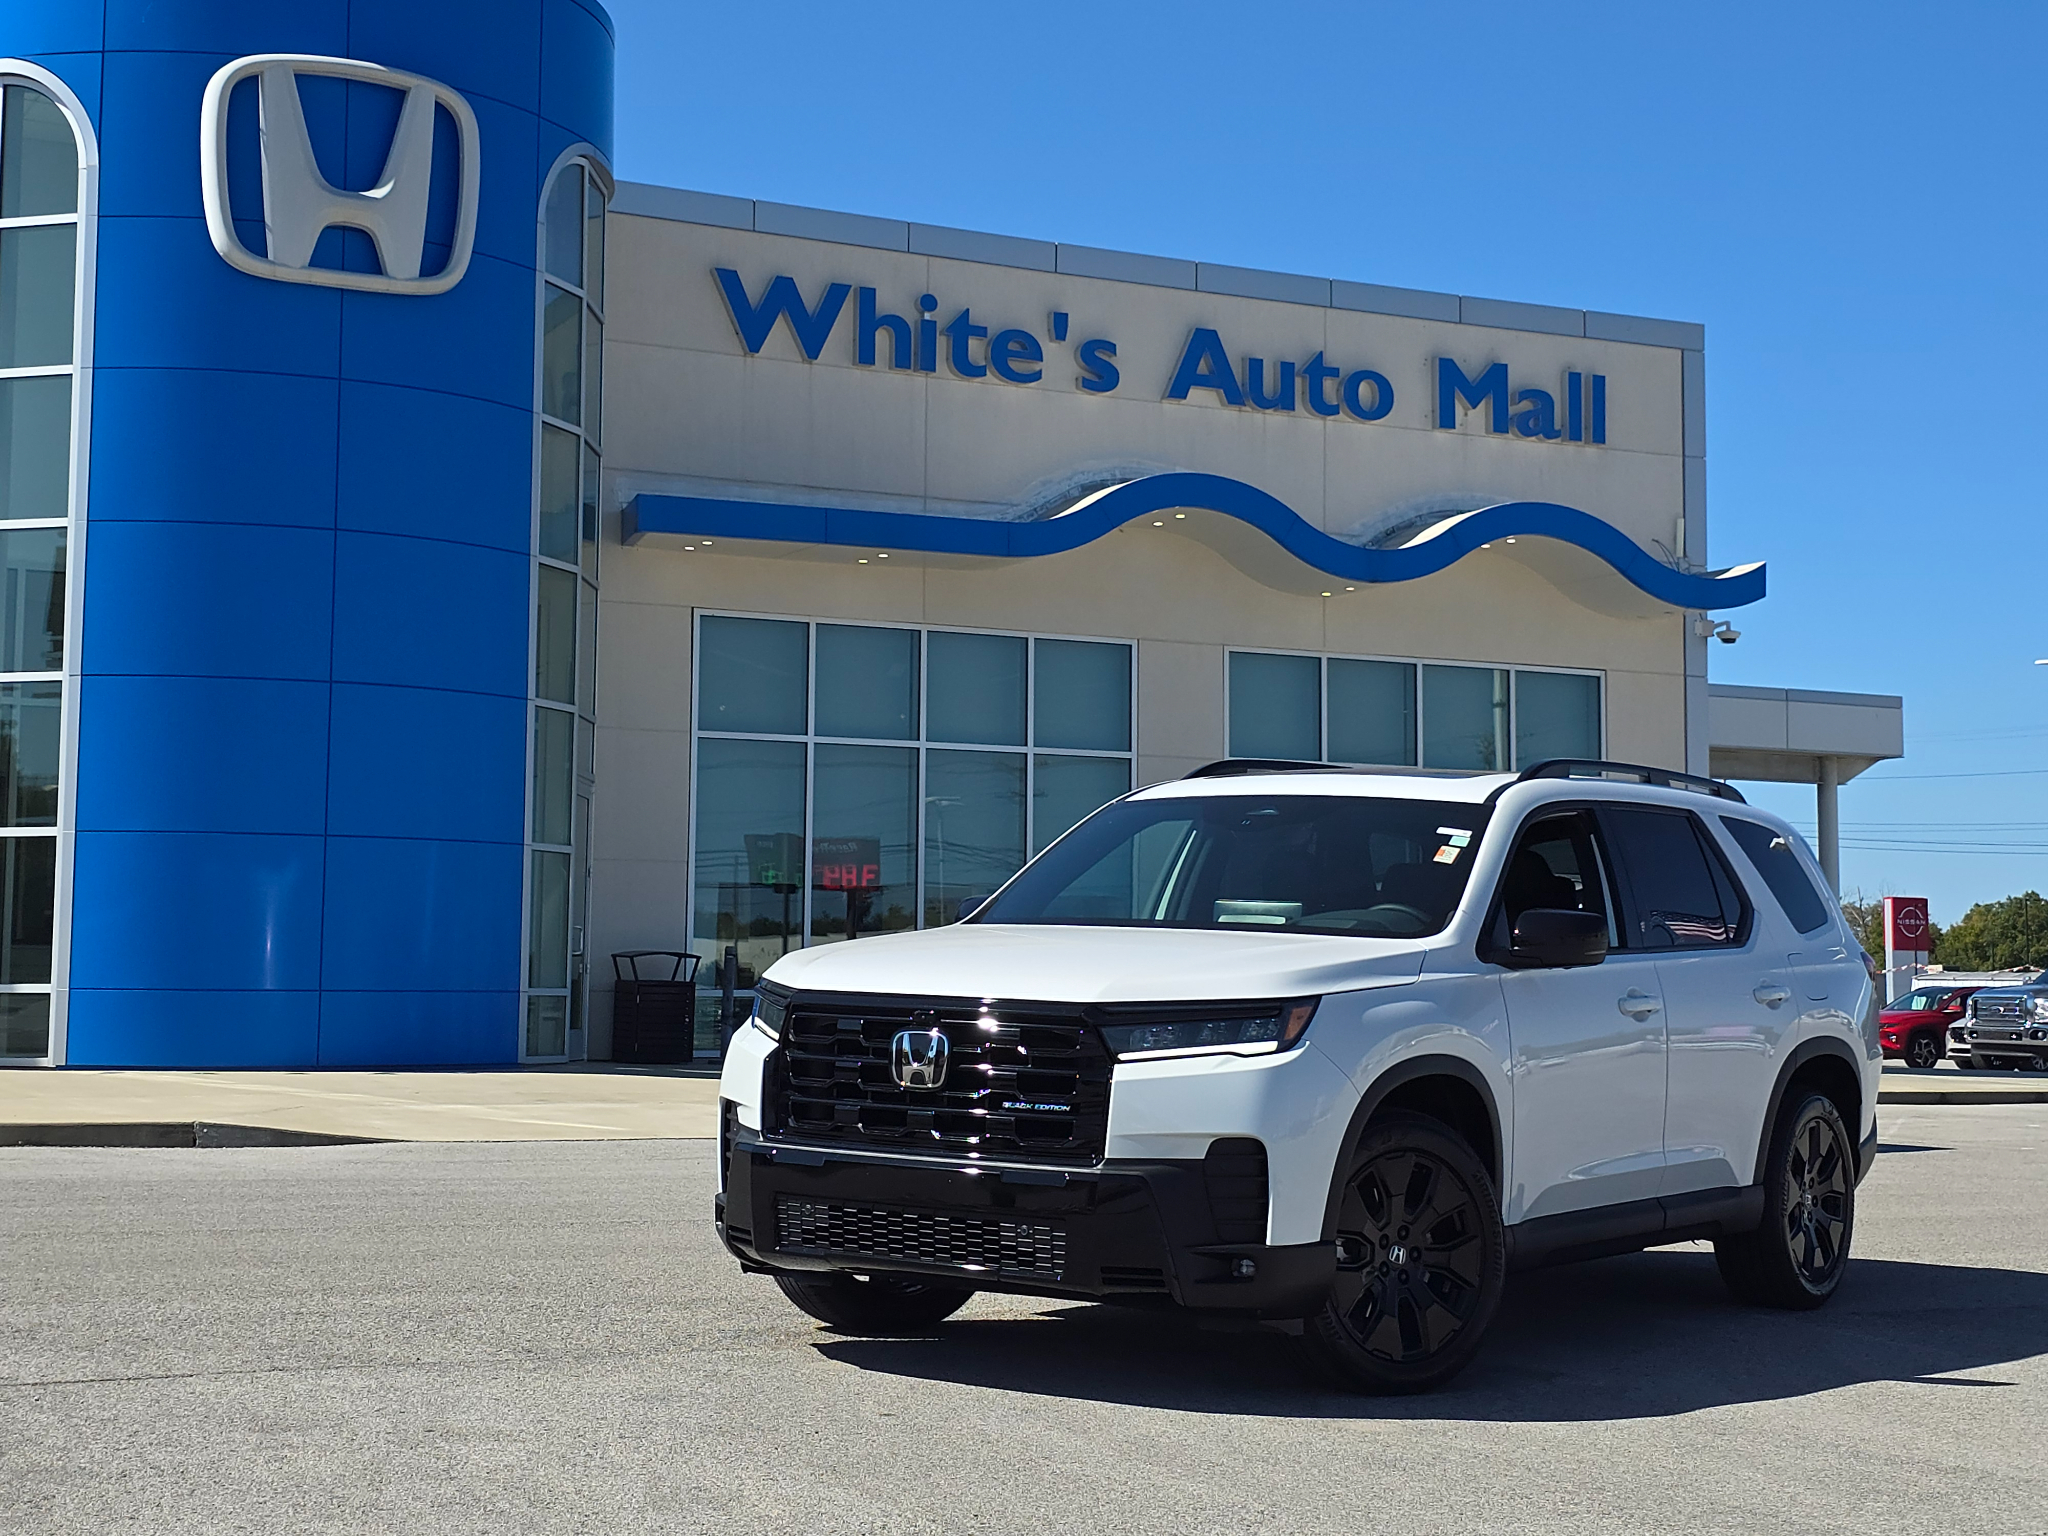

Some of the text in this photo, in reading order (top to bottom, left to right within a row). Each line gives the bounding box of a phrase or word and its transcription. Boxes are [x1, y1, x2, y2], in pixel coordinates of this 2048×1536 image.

[713, 267, 1607, 445] White's Auto Mall
[1001, 1101, 1071, 1111] BLACK EDITION
